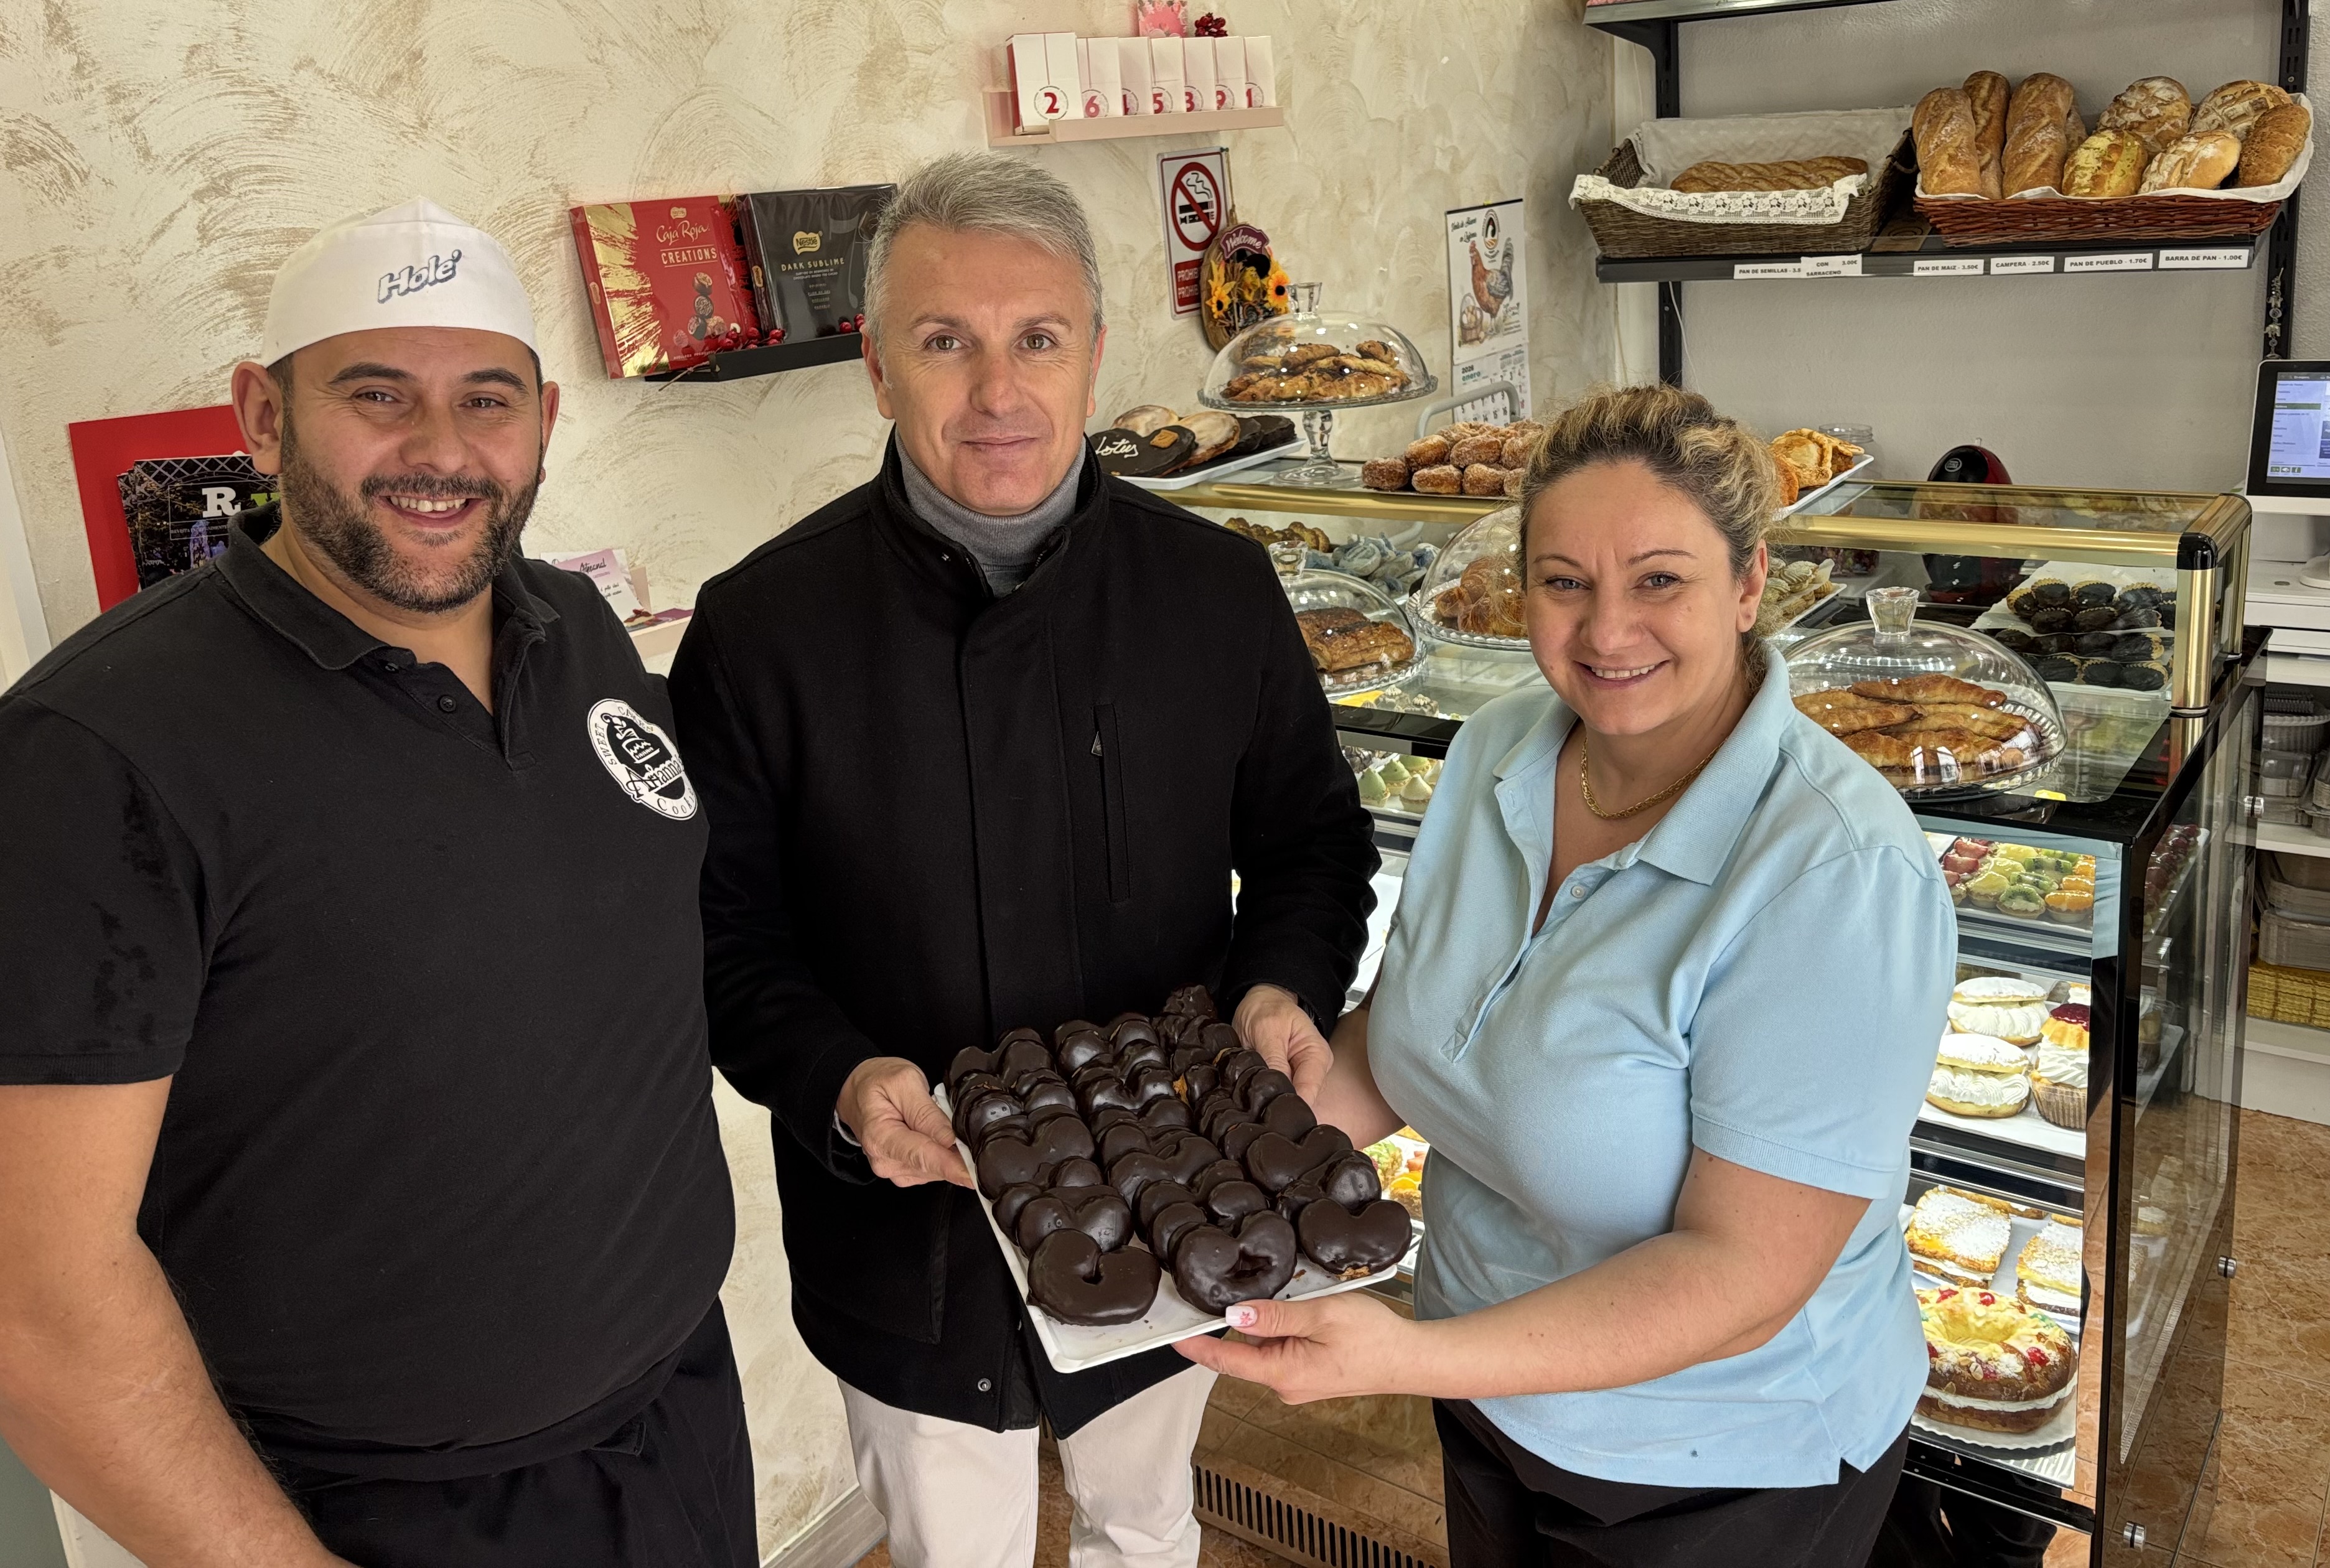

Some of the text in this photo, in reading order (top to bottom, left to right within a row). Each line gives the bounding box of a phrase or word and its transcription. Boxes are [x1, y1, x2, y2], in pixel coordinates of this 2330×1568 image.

[1044, 91, 1060, 114] 2
[1085, 95, 1100, 118] 6
[656, 220, 710, 246] Caja Roja
[1225, 229, 1263, 252] Welcome
[661, 247, 718, 265] CREATIONS
[781, 257, 845, 272] DARK SUBLIME
[594, 723, 618, 766] SWEET
